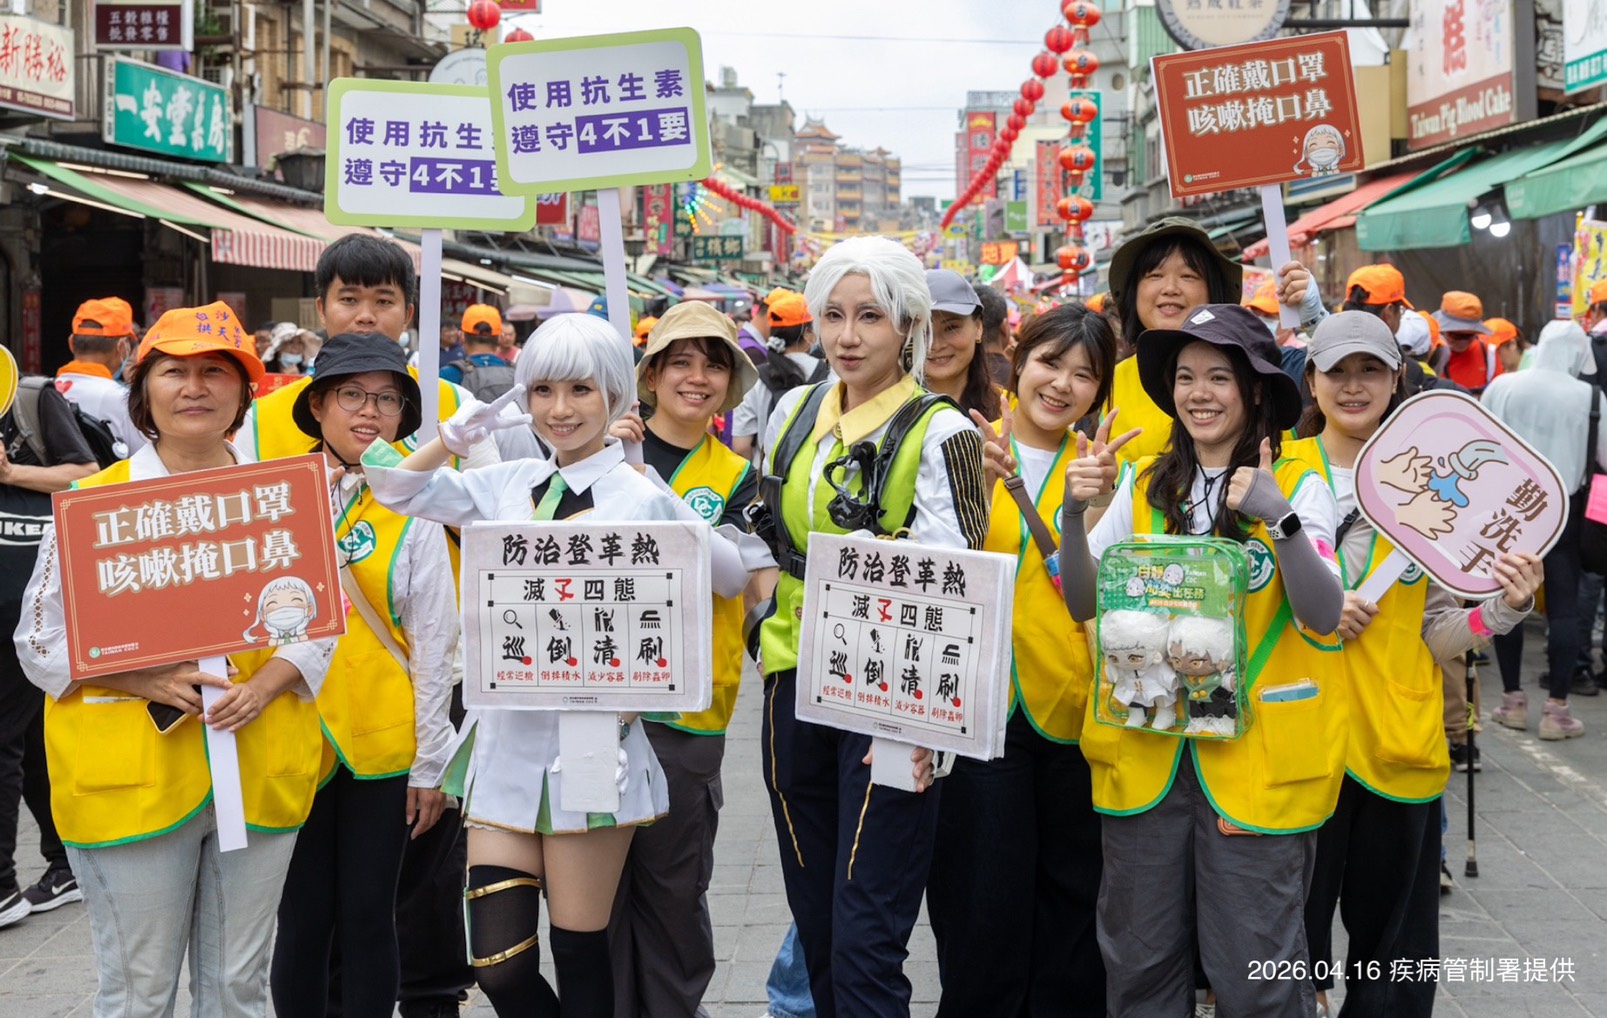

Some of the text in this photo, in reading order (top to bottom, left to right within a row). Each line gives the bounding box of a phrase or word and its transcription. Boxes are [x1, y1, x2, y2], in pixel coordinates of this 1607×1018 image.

[109, 10, 169, 25] 五穀雜糧
[109, 26, 170, 41] 批發零售
[508, 69, 684, 112] 使用抗生素
[1184, 53, 1327, 99] 正確戴口罩
[1187, 90, 1332, 135] 咳嗽掩口鼻
[1411, 84, 1511, 139] Taiwan Pig Blood Cake
[346, 117, 496, 150] 使用抗生
[511, 112, 690, 154] 遵守4不1要
[345, 158, 501, 191] 遵守4不1
[94, 482, 292, 546] 正確戴口罩
[1460, 478, 1549, 575] 勤洗手
[98, 531, 299, 593] 咳嗽掩口鼻
[502, 532, 660, 566] 防治登革熱
[838, 547, 966, 597] 防治登革熱
[502, 636, 527, 662] 巡
[547, 636, 572, 664] 倒
[593, 635, 619, 665] 清
[637, 637, 663, 665] 刷
[829, 650, 848, 678] 巡
[541, 670, 581, 681] 倒掉積水
[588, 671, 625, 682] 減少容器
[864, 658, 884, 686] 倒
[901, 665, 921, 695] 清
[936, 674, 959, 703] 刷
